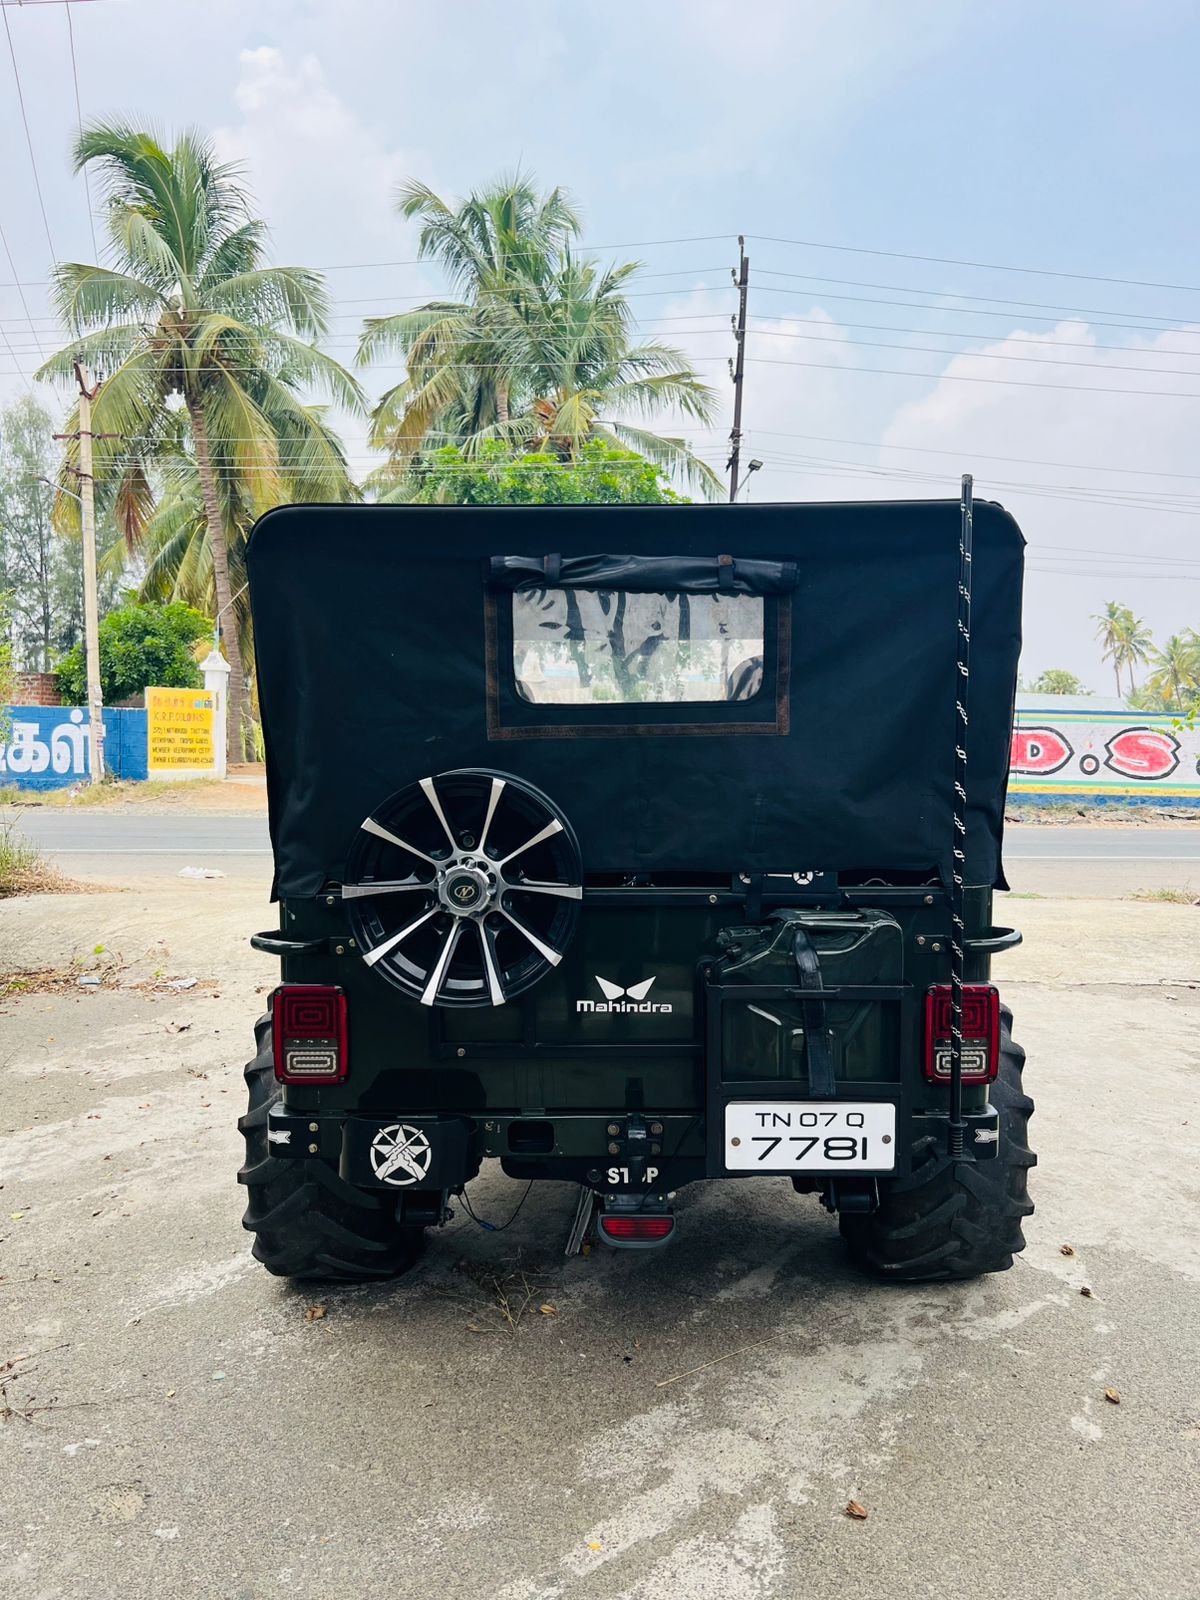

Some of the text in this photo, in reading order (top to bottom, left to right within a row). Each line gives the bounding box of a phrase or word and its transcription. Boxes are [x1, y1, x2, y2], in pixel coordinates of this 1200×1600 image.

[0, 708, 106, 774] கள்
[576, 1000, 673, 1013] Mahindra
[755, 1112, 865, 1129] TN 07 Q
[751, 1136, 868, 1161] 7781
[607, 1167, 659, 1184] STP
